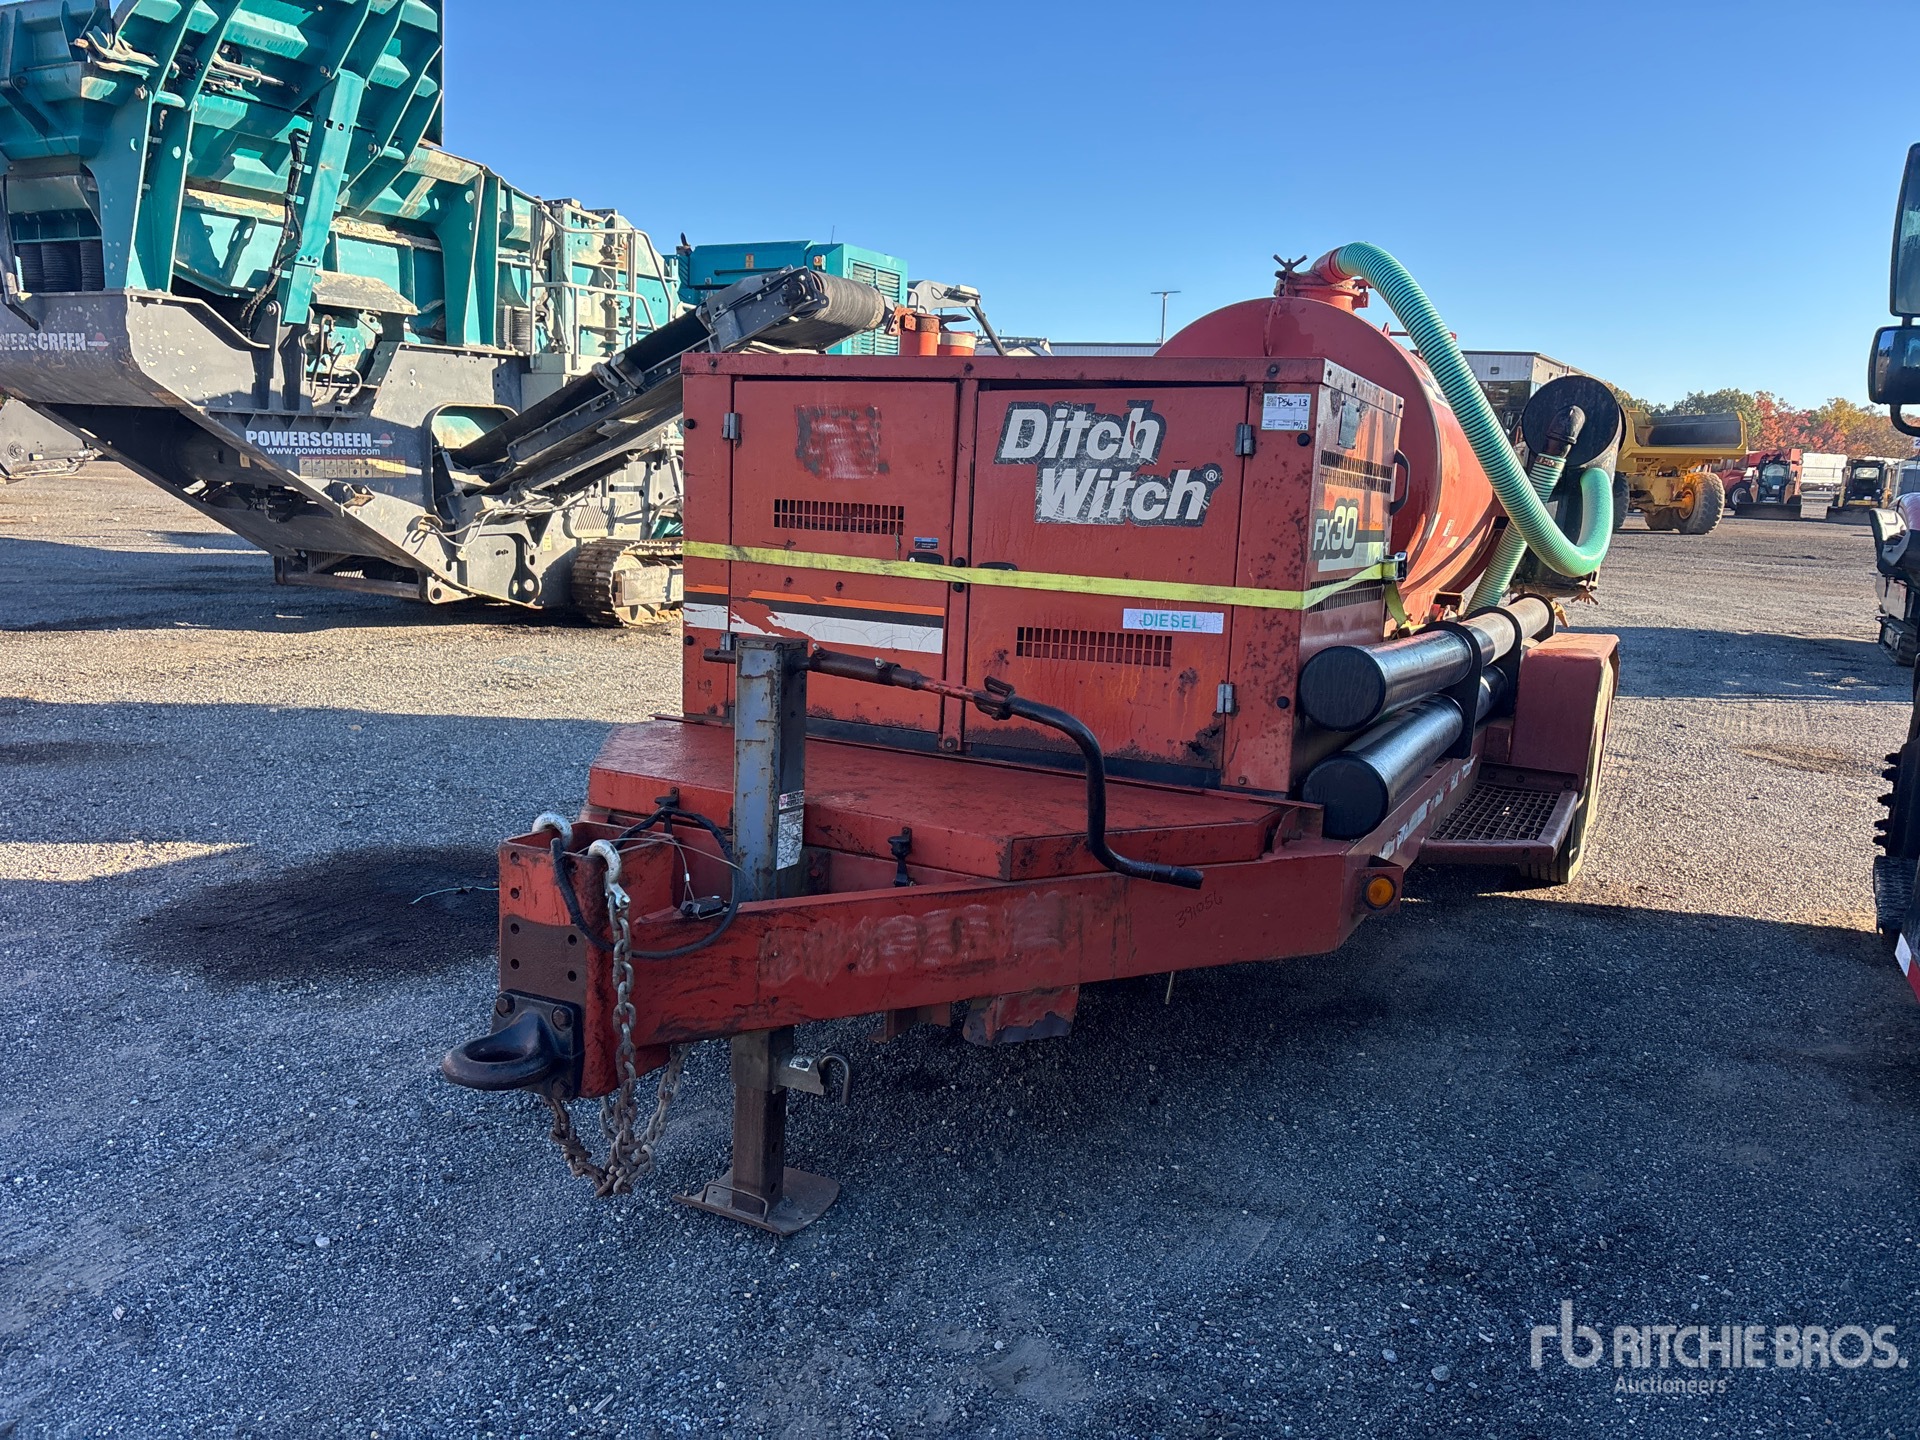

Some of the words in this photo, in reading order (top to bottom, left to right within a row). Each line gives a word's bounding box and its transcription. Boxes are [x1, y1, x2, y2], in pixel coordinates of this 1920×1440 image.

[245, 430, 372, 447] POWERSCREEN
[1000, 407, 1160, 460] Ditch
[266, 447, 381, 456] www.powerscreen.com
[1312, 504, 1358, 551] FX30
[1142, 612, 1202, 630] DIESEL
